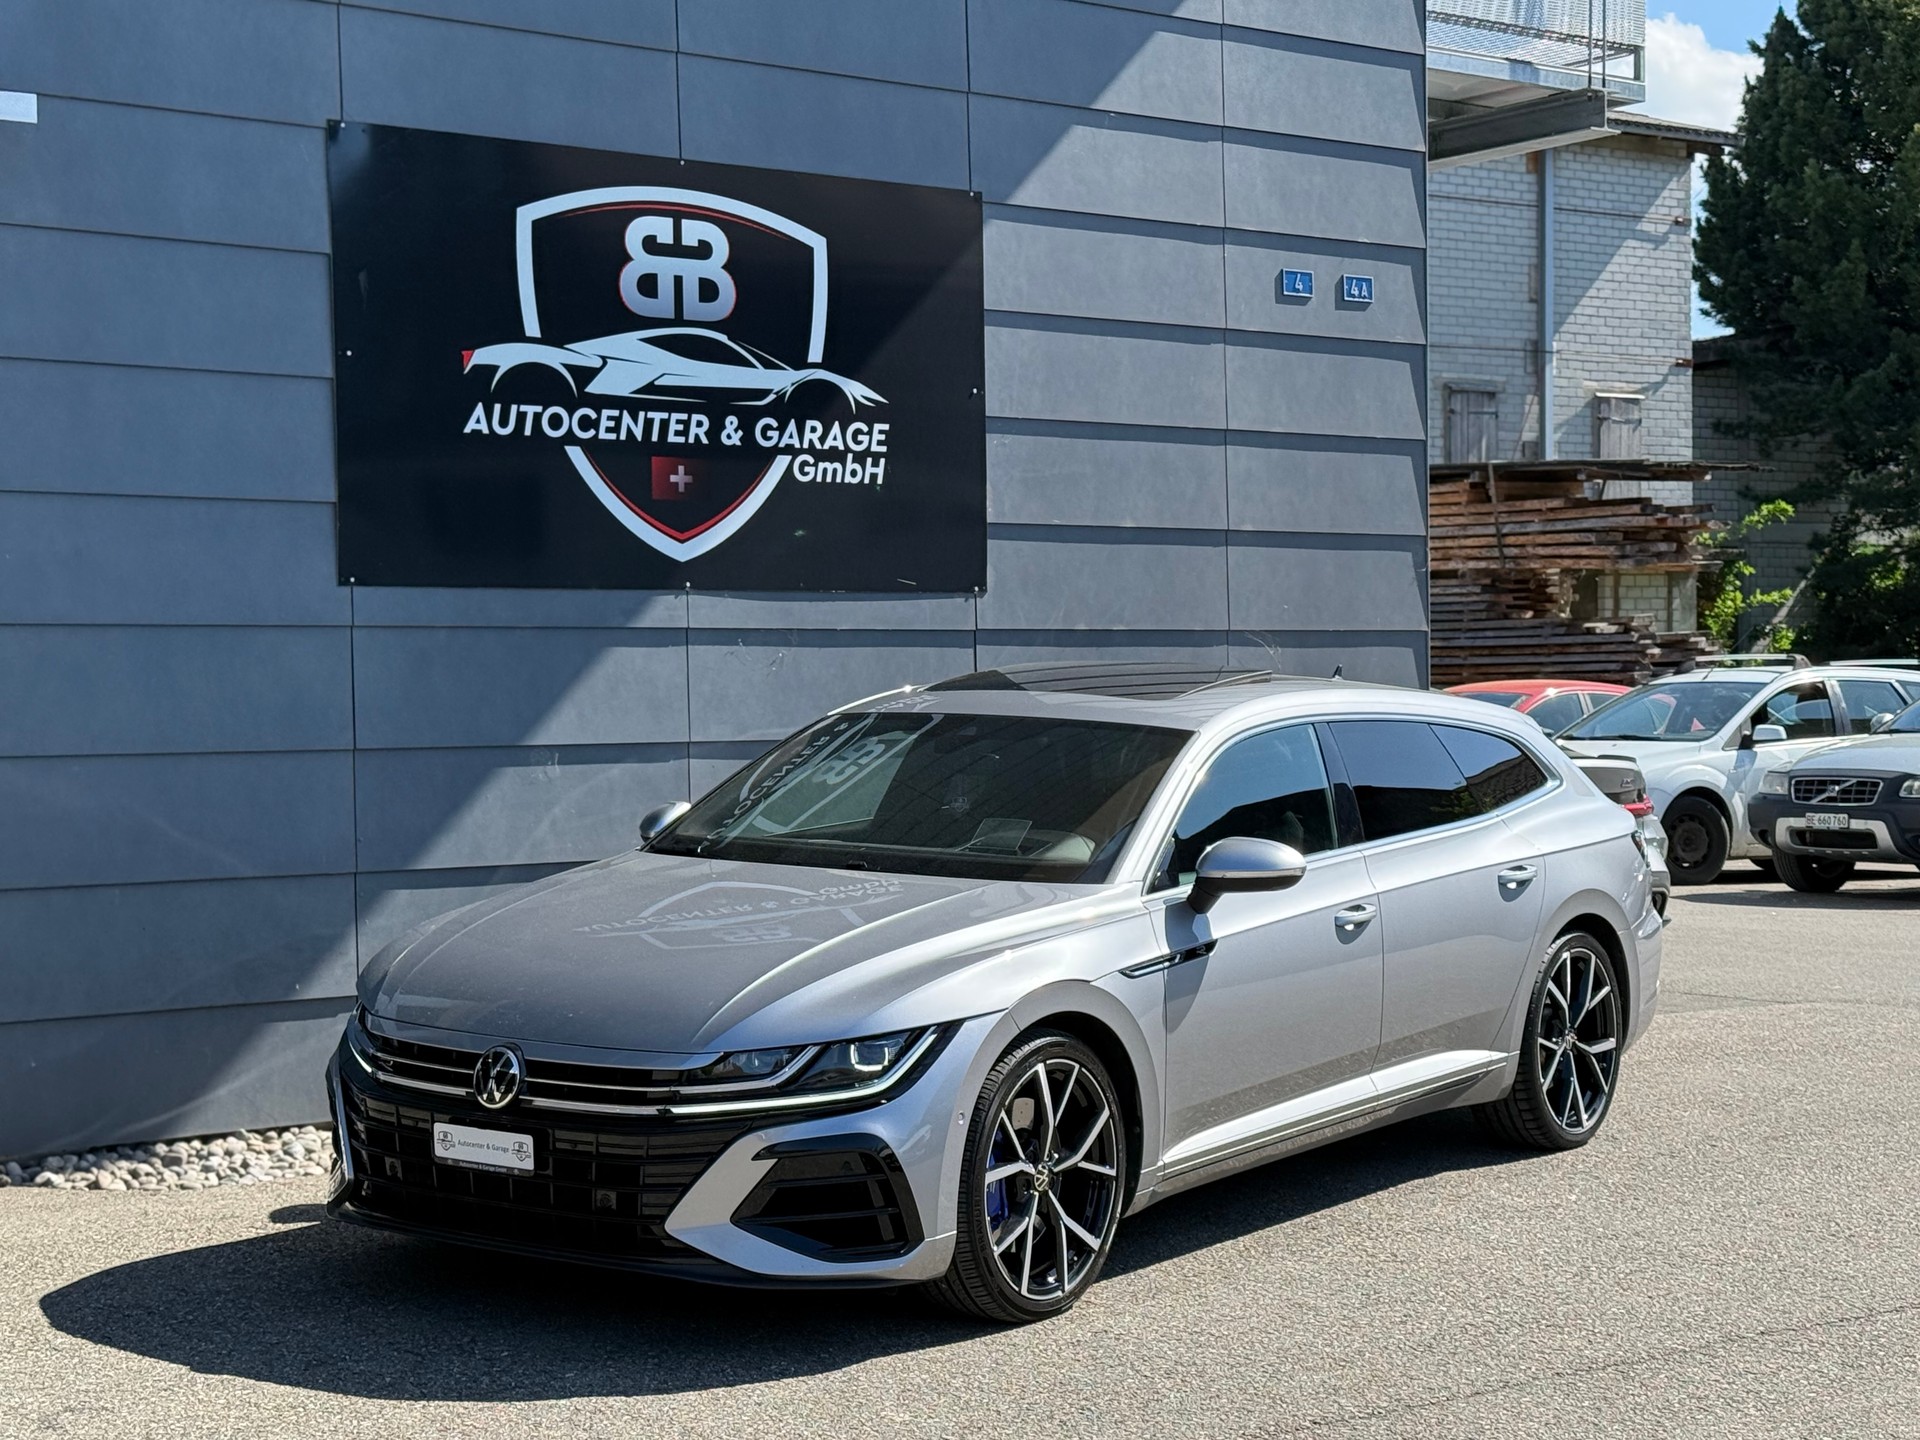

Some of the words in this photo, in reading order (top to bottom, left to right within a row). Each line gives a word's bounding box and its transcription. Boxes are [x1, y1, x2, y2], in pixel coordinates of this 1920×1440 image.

[1295, 273, 1303, 291] 4
[1350, 279, 1368, 297] 4A
[463, 402, 710, 445] AUTOCENTER
[721, 417, 743, 446] &
[755, 418, 890, 453] GARAGE
[792, 453, 886, 485] GmbH
[1806, 815, 1816, 825] BE
[457, 1139, 485, 1149] Autocenter
[491, 1144, 510, 1153] Garage
